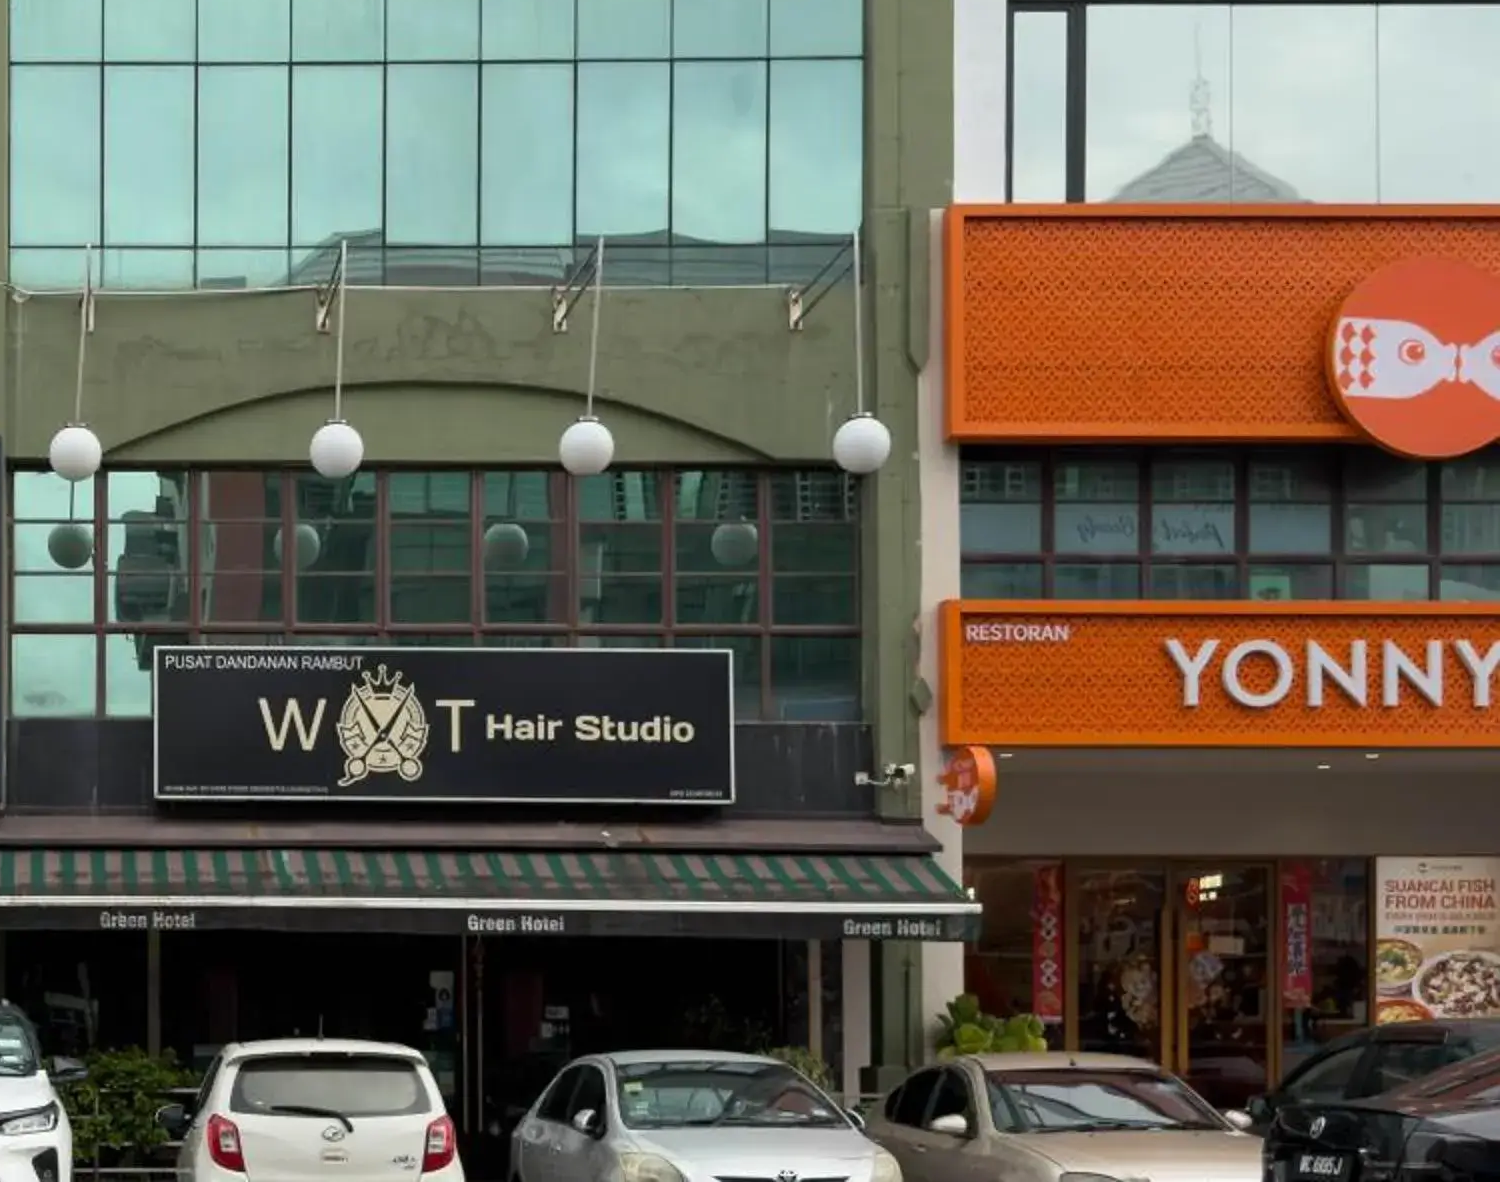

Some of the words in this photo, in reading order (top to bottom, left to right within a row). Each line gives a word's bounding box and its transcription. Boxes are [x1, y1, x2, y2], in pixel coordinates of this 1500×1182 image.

[965, 624, 1070, 642] RESTORAN
[165, 655, 212, 669] PUSAT
[215, 655, 298, 669] DANDANAN
[301, 656, 364, 670] RAMBUT
[1164, 638, 1500, 708] YONNY
[258, 697, 327, 752] W
[435, 699, 476, 753] T
[485, 714, 564, 740] Hair
[574, 714, 696, 743] Studio
[1384, 879, 1454, 893] SUANCAI
[1458, 879, 1495, 892] FISH
[1385, 895, 1437, 909] FROM
[1441, 895, 1496, 909] CHINA
[100, 912, 148, 929] Green
[153, 912, 196, 929] Hotel
[467, 914, 516, 932] Green
[521, 914, 565, 932] Hotel
[843, 919, 892, 936] Green
[897, 919, 941, 936] Hotel
